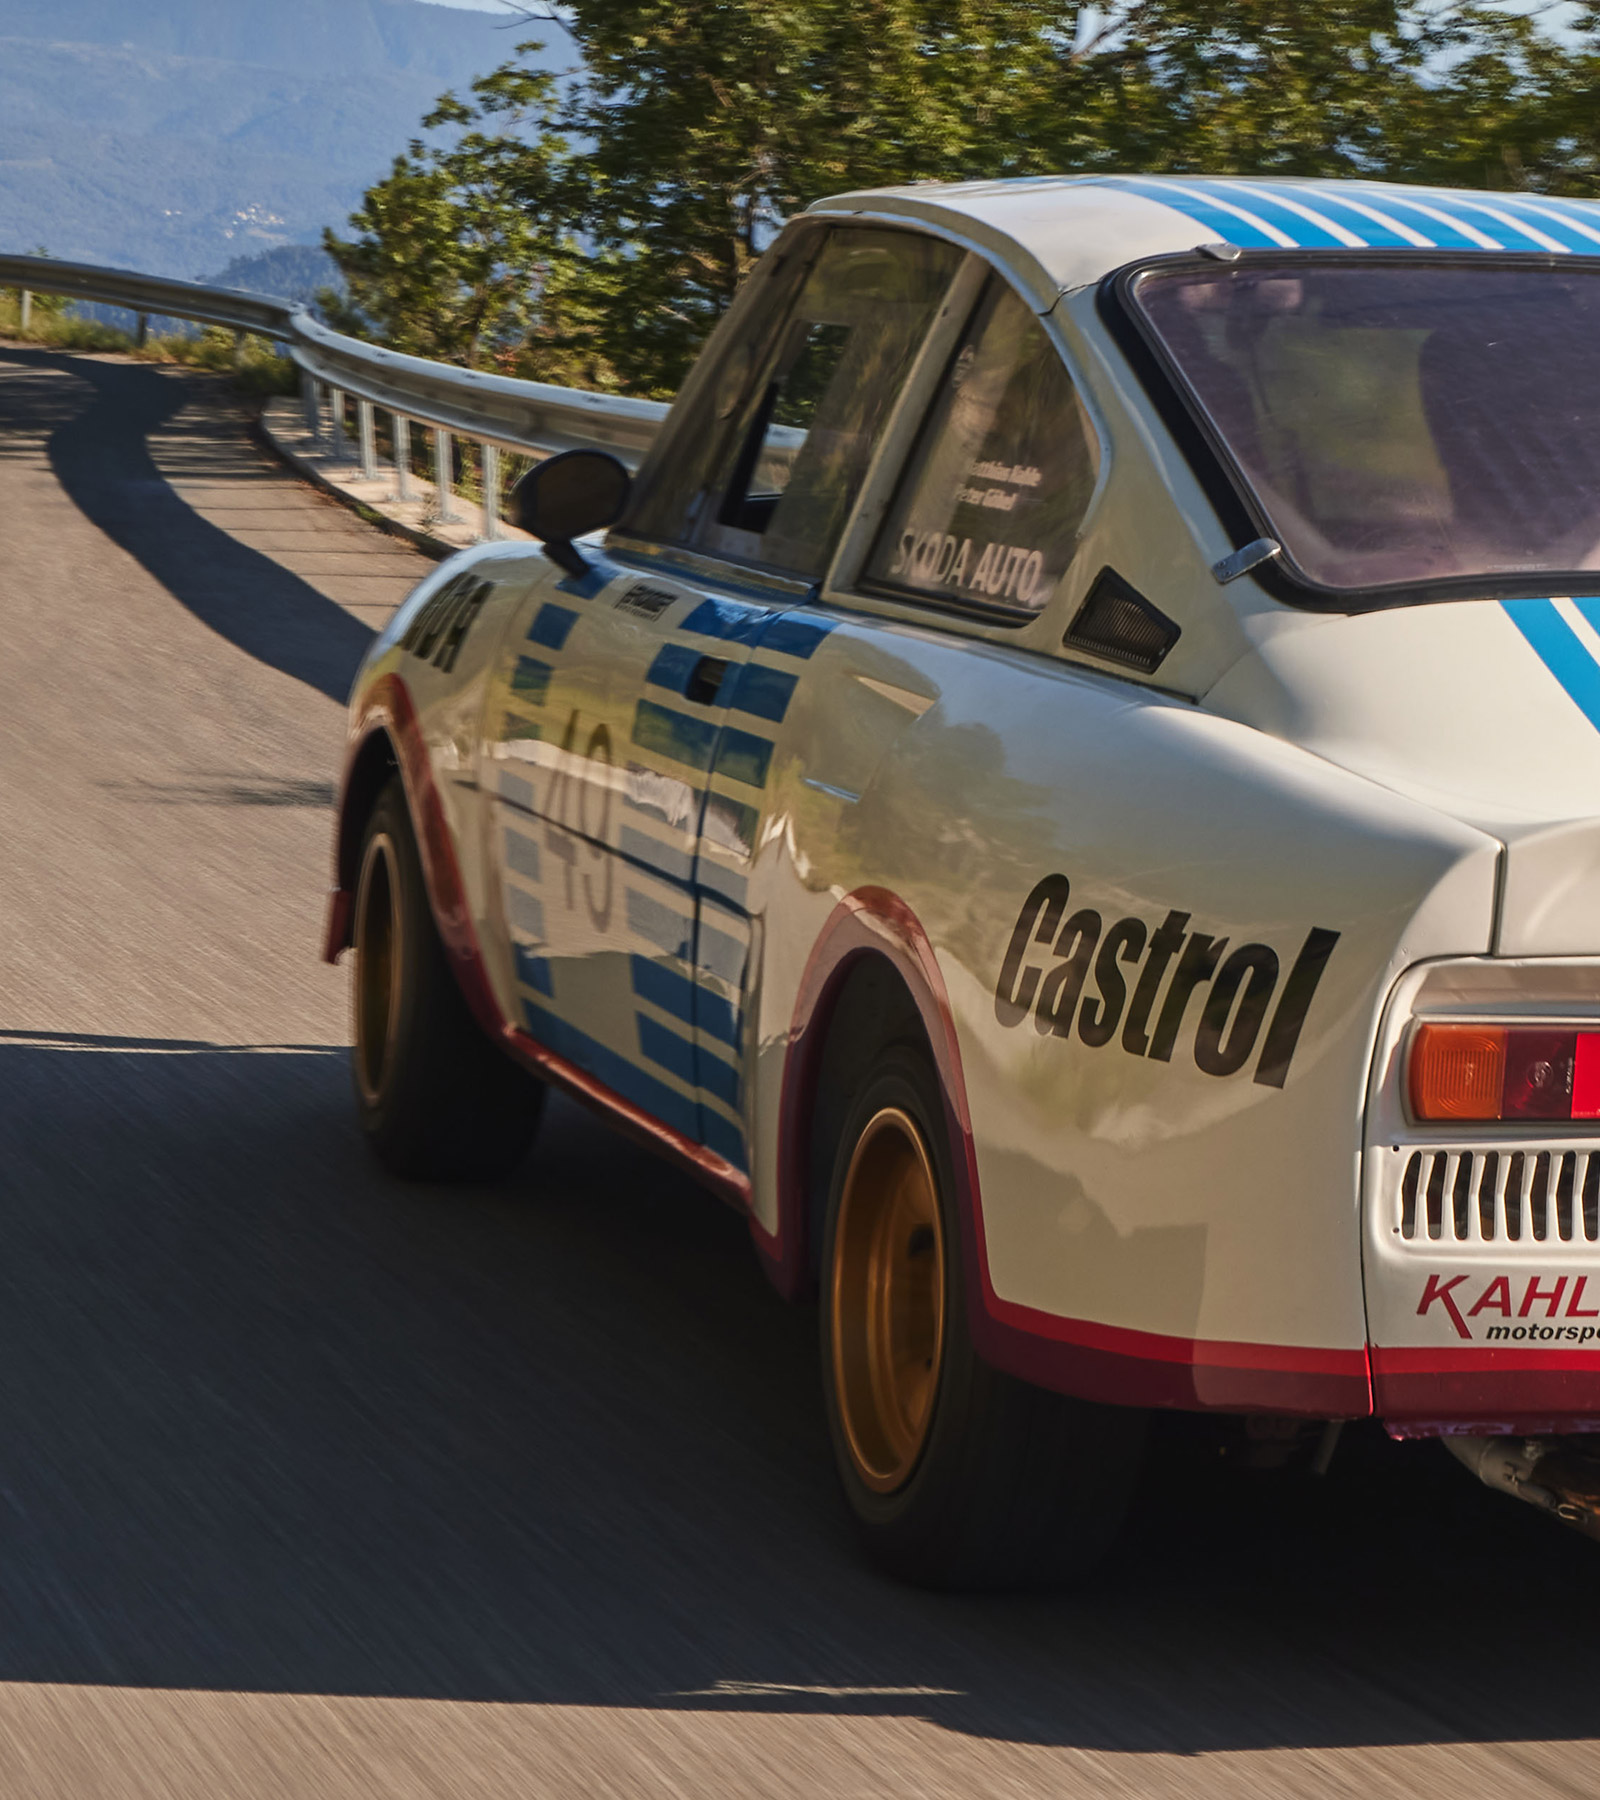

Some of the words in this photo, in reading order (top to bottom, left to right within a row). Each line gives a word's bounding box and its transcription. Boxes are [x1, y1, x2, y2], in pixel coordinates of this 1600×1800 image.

[969, 542, 1044, 601] AUTO
[544, 708, 613, 933] 49
[994, 873, 1342, 1089] Castrol
